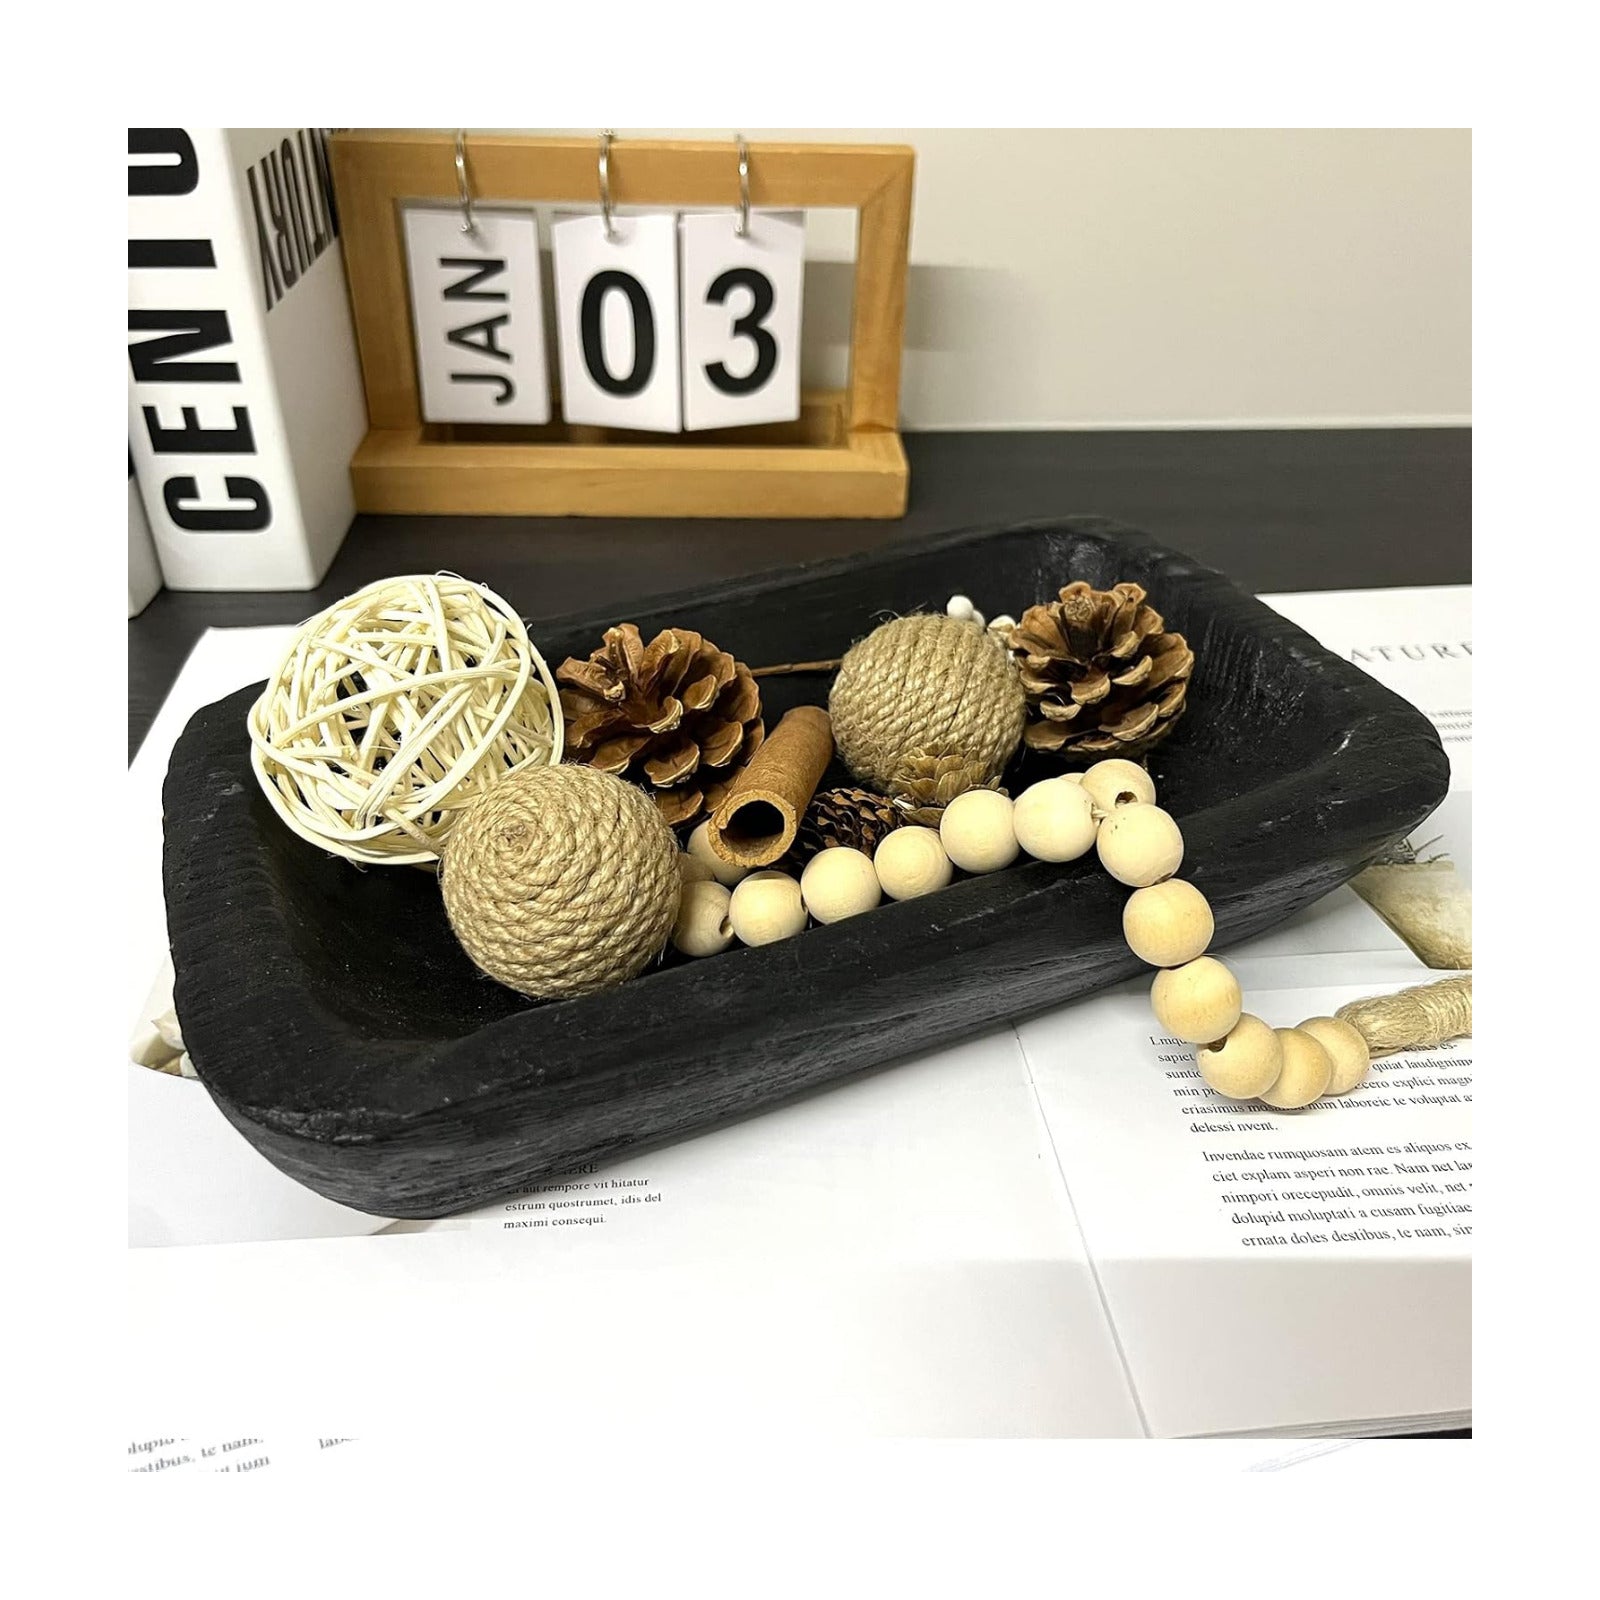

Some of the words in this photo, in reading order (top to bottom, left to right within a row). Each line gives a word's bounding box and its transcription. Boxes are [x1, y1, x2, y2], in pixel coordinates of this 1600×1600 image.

[439, 257, 514, 405] JAN
[1372, 1060, 1403, 1072] quiat
[1173, 1086, 1200, 1096] min
[1392, 1075, 1435, 1089] explici
[1181, 1103, 1245, 1115] eriasimus
[1394, 1098, 1407, 1106] te
[1408, 1093, 1462, 1106] voluptat
[1190, 1121, 1235, 1133] delessi
[1202, 1149, 1266, 1162] Invendae
[1267, 1147, 1349, 1161] rumquosam
[1349, 1146, 1385, 1156] atem
[1386, 1146, 1402, 1154] es
[1403, 1142, 1452, 1155] aliquos
[1212, 1170, 1239, 1182] ciet
[1241, 1169, 1291, 1183] explam
[1293, 1166, 1337, 1181] asperi
[1338, 1167, 1365, 1177] non
[1393, 1162, 1430, 1175] Nam
[1430, 1162, 1454, 1172] net
[610, 1177, 650, 1189] hitatur
[504, 1201, 546, 1213] estrum
[547, 1196, 618, 1212] quostrumet,
[620, 1194, 643, 1206] idis
[644, 1192, 662, 1204] del
[1221, 1190, 1279, 1205] nimpori
[1361, 1184, 1405, 1197] omnis
[1406, 1182, 1444, 1195] velit,
[1444, 1182, 1468, 1193] net
[503, 1217, 549, 1231] maximi
[1231, 1211, 1287, 1226] dolupid
[1287, 1206, 1357, 1223] moluptati
[1358, 1210, 1369, 1219] a
[1370, 1207, 1417, 1218] cusam
[1241, 1235, 1289, 1247] ernata
[1290, 1231, 1330, 1245] doles
[1331, 1228, 1397, 1243] destibus,
[1396, 1228, 1413, 1239] te
[1414, 1227, 1453, 1238] nam,
